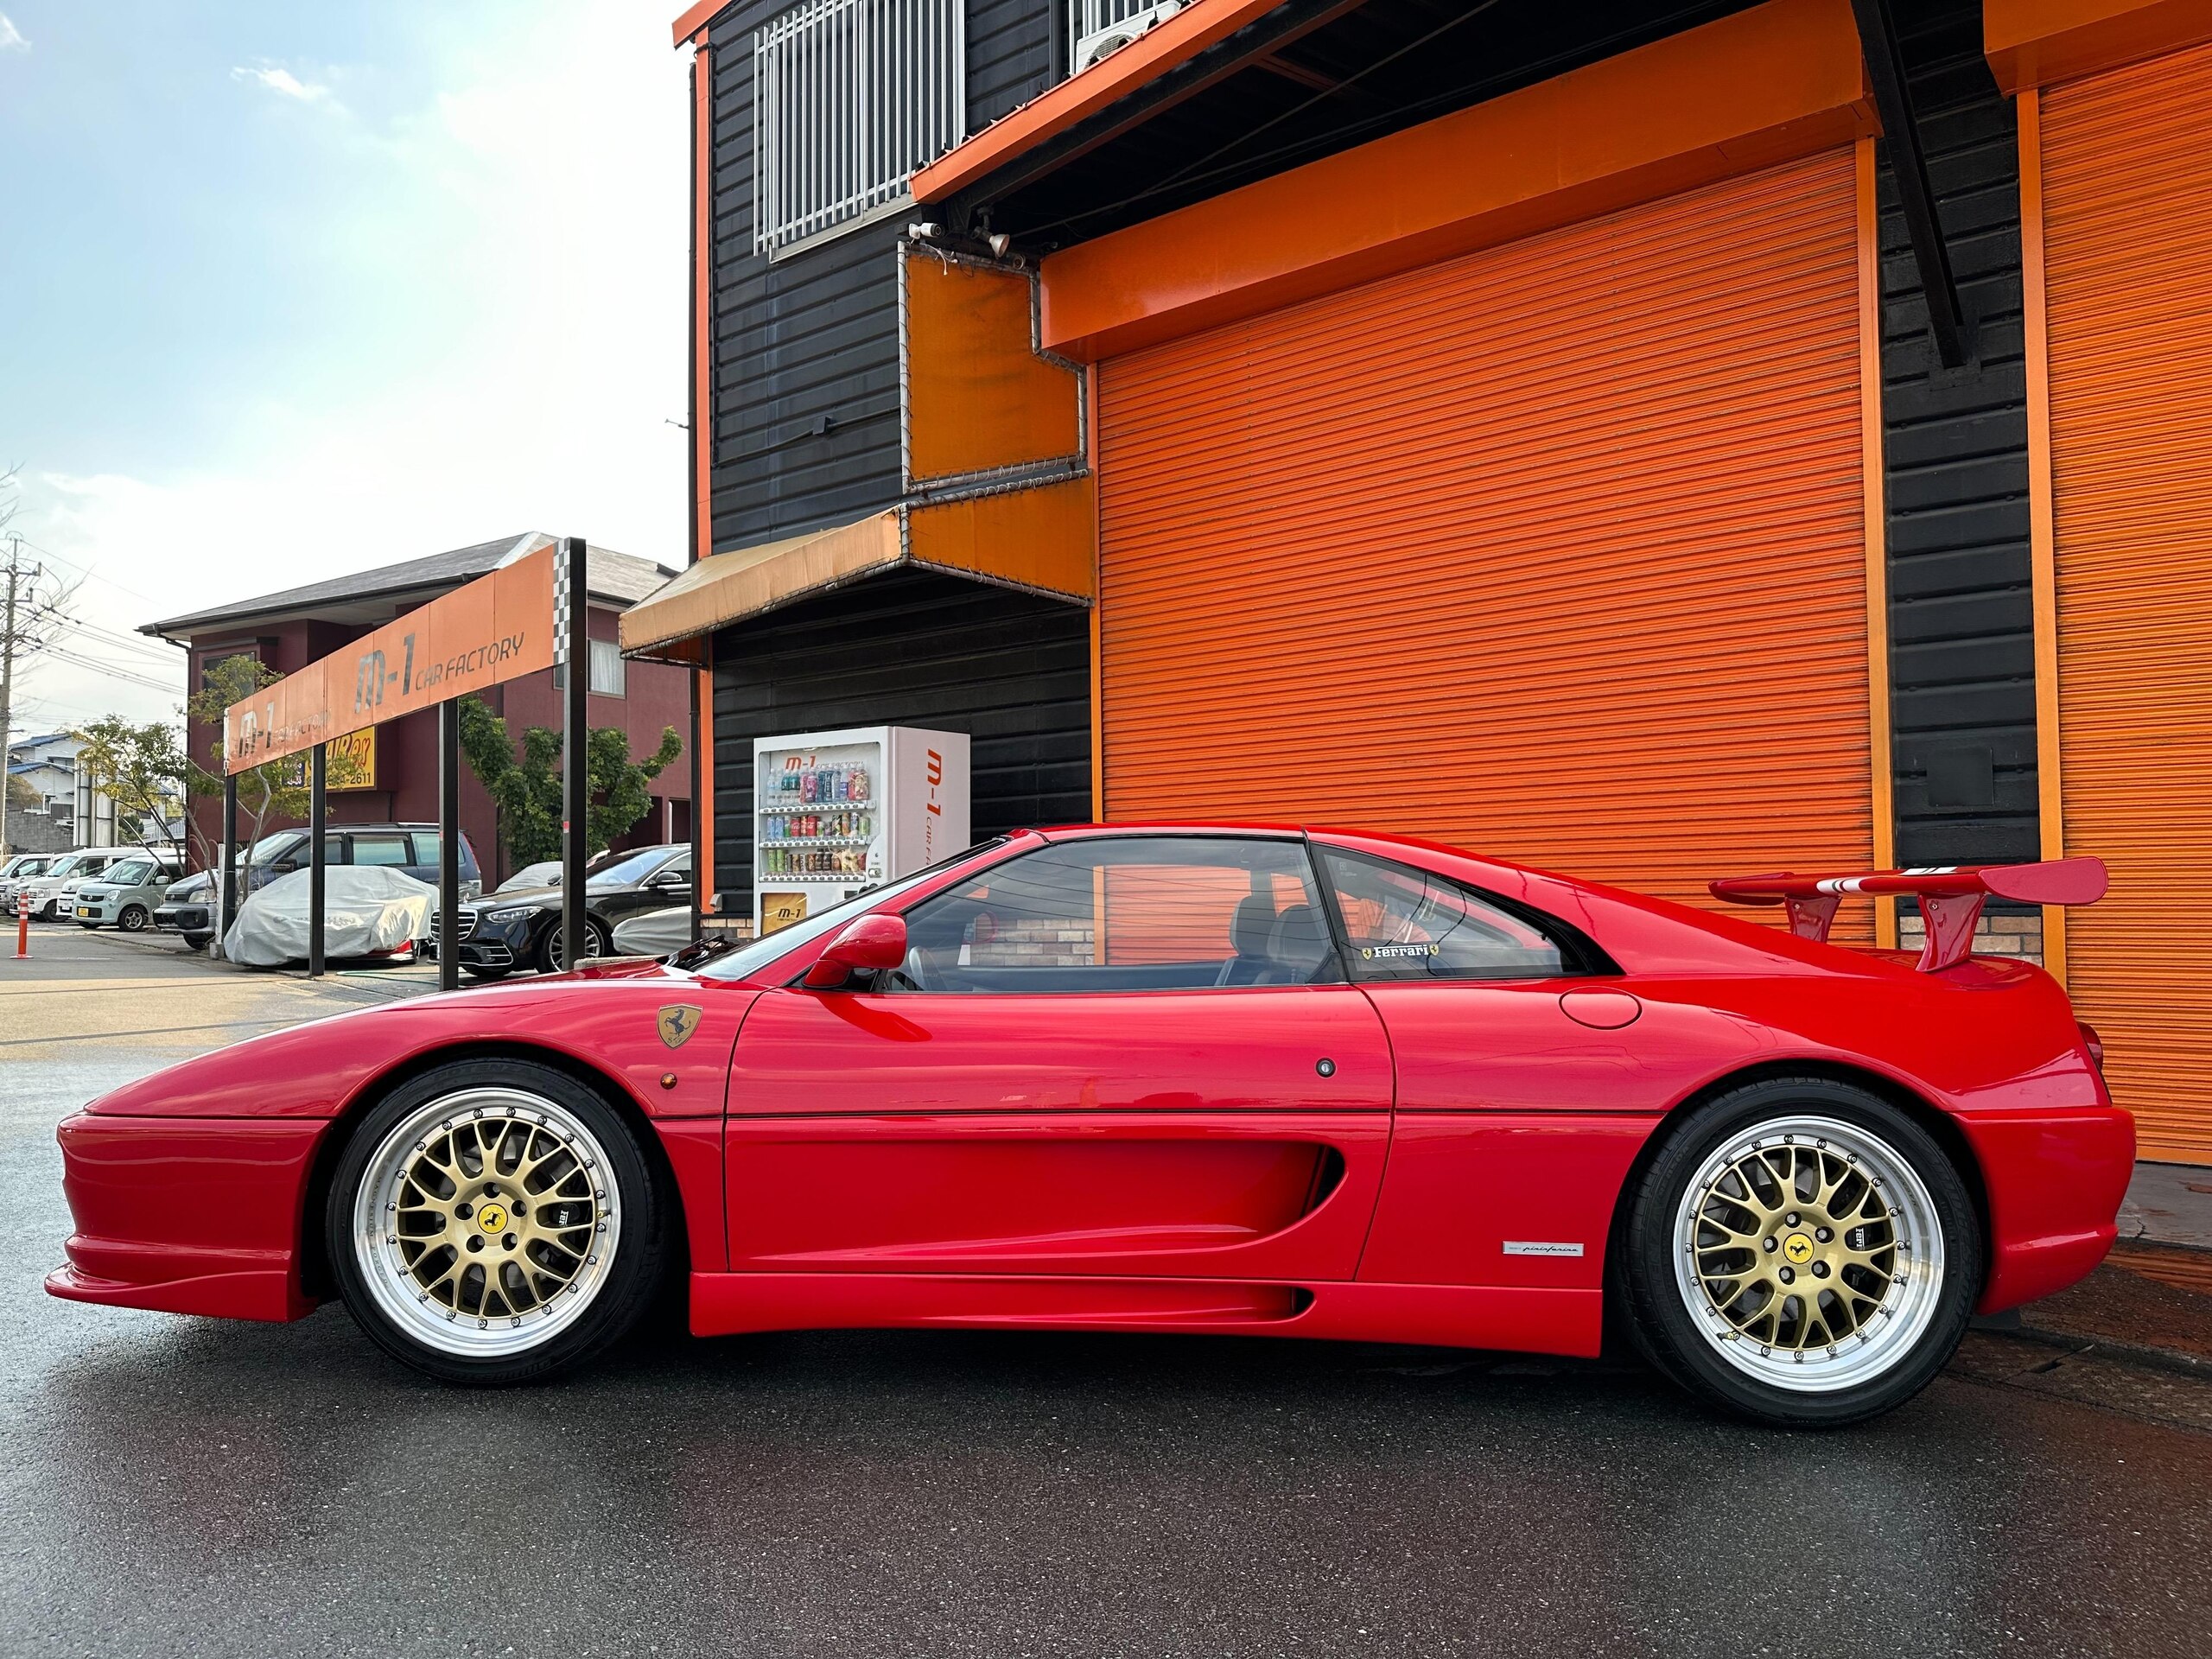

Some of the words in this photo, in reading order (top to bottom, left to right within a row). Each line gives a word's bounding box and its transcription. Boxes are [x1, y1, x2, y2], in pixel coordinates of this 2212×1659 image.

[416, 663, 443, 691] CAR
[445, 632, 524, 680] FACTORY
[1373, 944, 1429, 958] Ferrari
